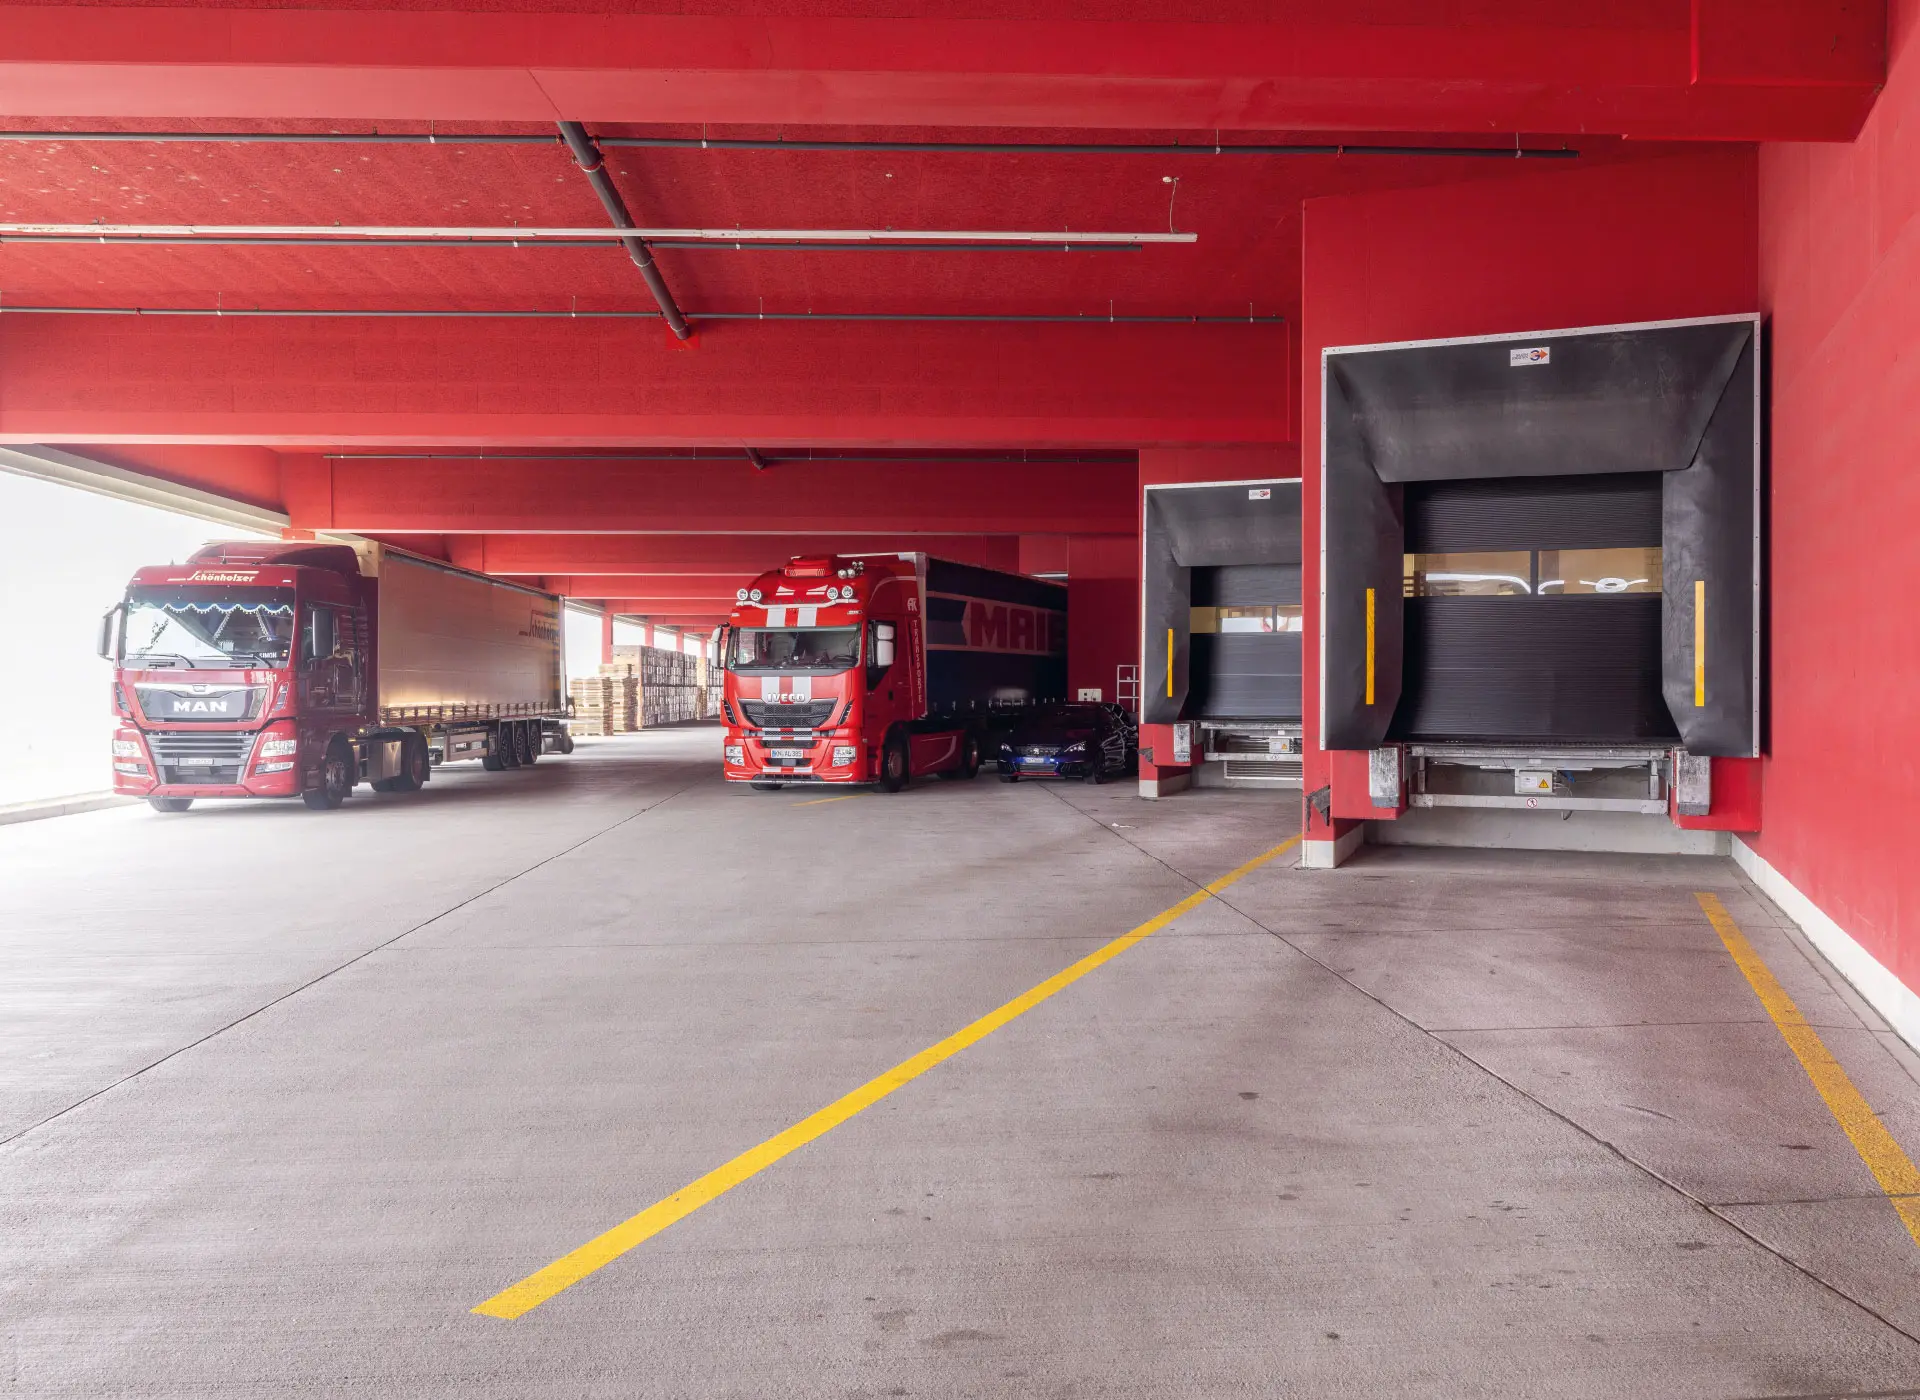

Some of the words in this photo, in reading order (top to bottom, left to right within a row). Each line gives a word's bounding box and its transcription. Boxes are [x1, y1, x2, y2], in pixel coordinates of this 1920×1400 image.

[187, 570, 259, 582] Schönholzer
[913, 619, 923, 703] TRANSPORTE
[767, 693, 805, 702] IVECO
[173, 701, 228, 712] MAN
